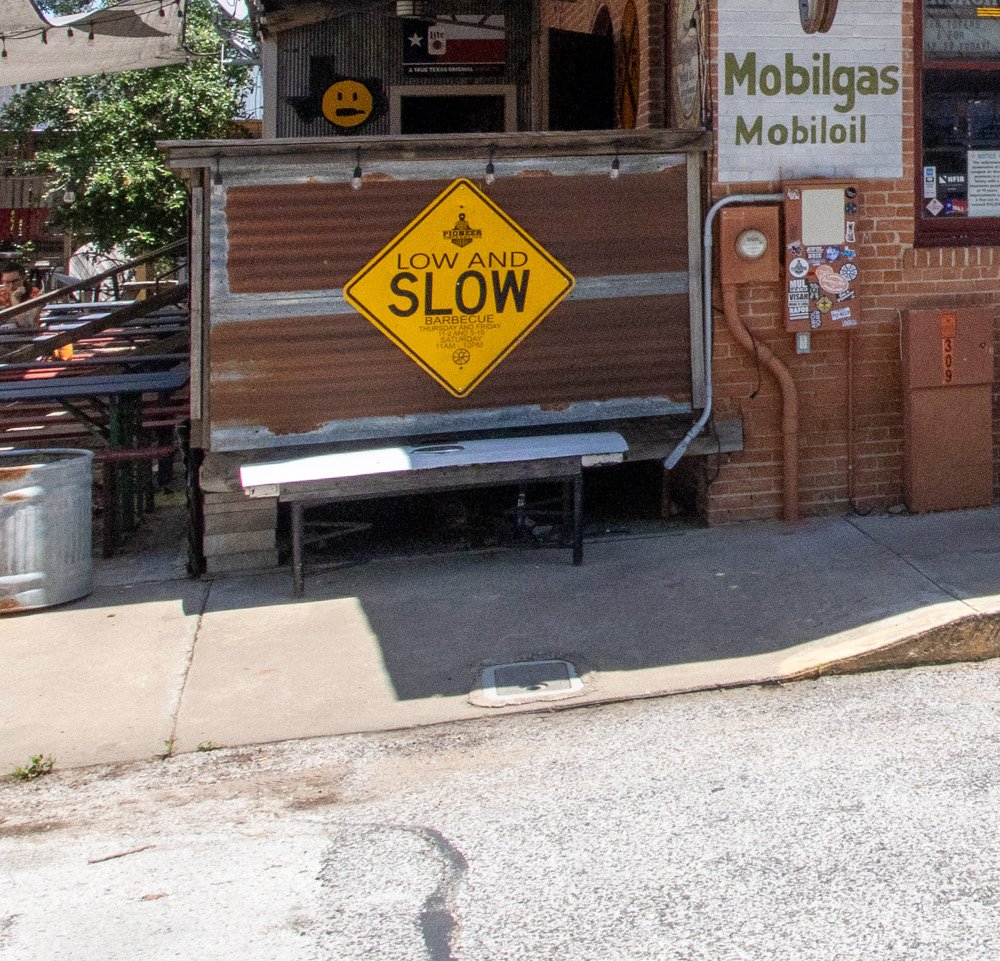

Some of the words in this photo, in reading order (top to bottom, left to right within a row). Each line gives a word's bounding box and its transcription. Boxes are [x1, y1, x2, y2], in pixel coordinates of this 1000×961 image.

[724, 52, 900, 113] Mobilgas
[735, 115, 866, 146] Mobiloil
[397, 252, 459, 270] LOW
[467, 251, 528, 269] AND
[388, 269, 531, 318] SLOW
[425, 314, 494, 326] BARBECUE
